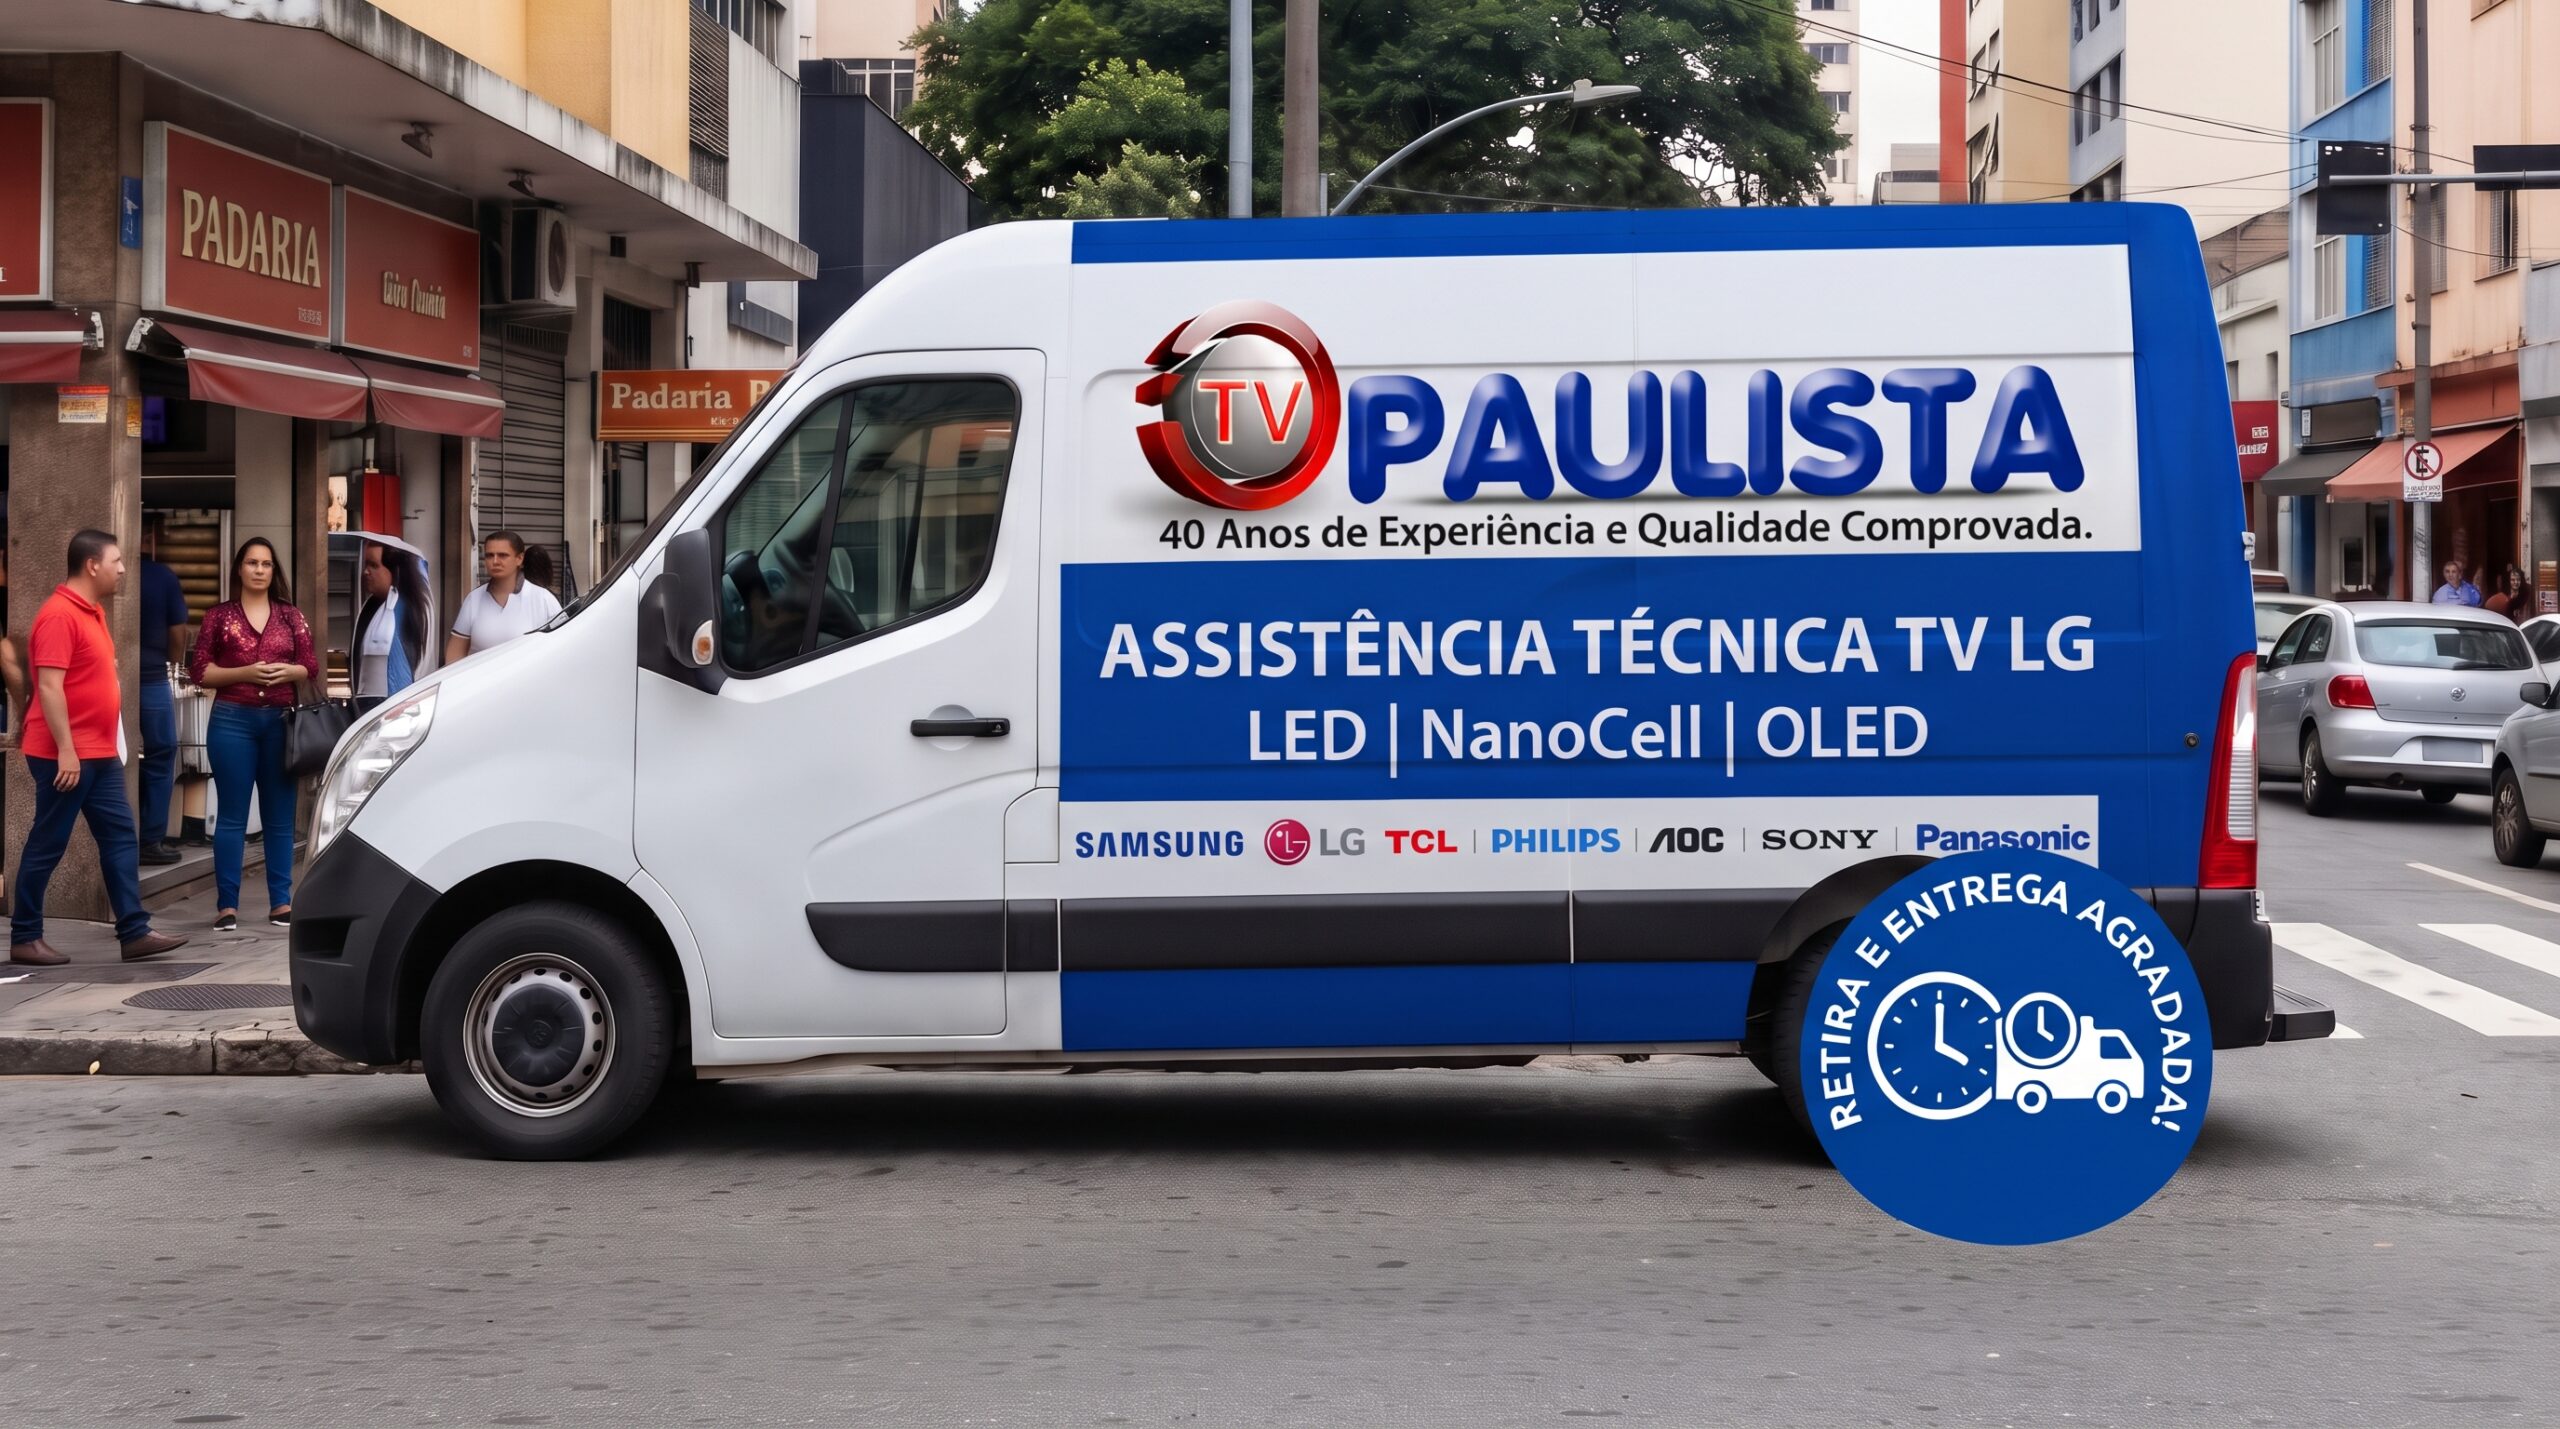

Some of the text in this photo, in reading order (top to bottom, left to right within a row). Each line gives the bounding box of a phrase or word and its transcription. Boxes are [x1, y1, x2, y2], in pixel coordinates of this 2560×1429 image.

[182, 188, 321, 288] PADARIA
[610, 381, 732, 409] Padaria
[1198, 365, 2085, 504] TV PAULISTA
[1159, 508, 2093, 554] 40 Anos de Experiência e Qualidade Comprovada.
[1100, 607, 2094, 678] ASSISTÊNCIA TÉCNICA TV LG
[1249, 709, 1366, 761] LED
[1422, 705, 1700, 759] NanoCell
[1757, 705, 1928, 758] OLED
[1075, 824, 2090, 858] SAMSUNG LG TCL PHILIPS AOC SONY Panasonic
